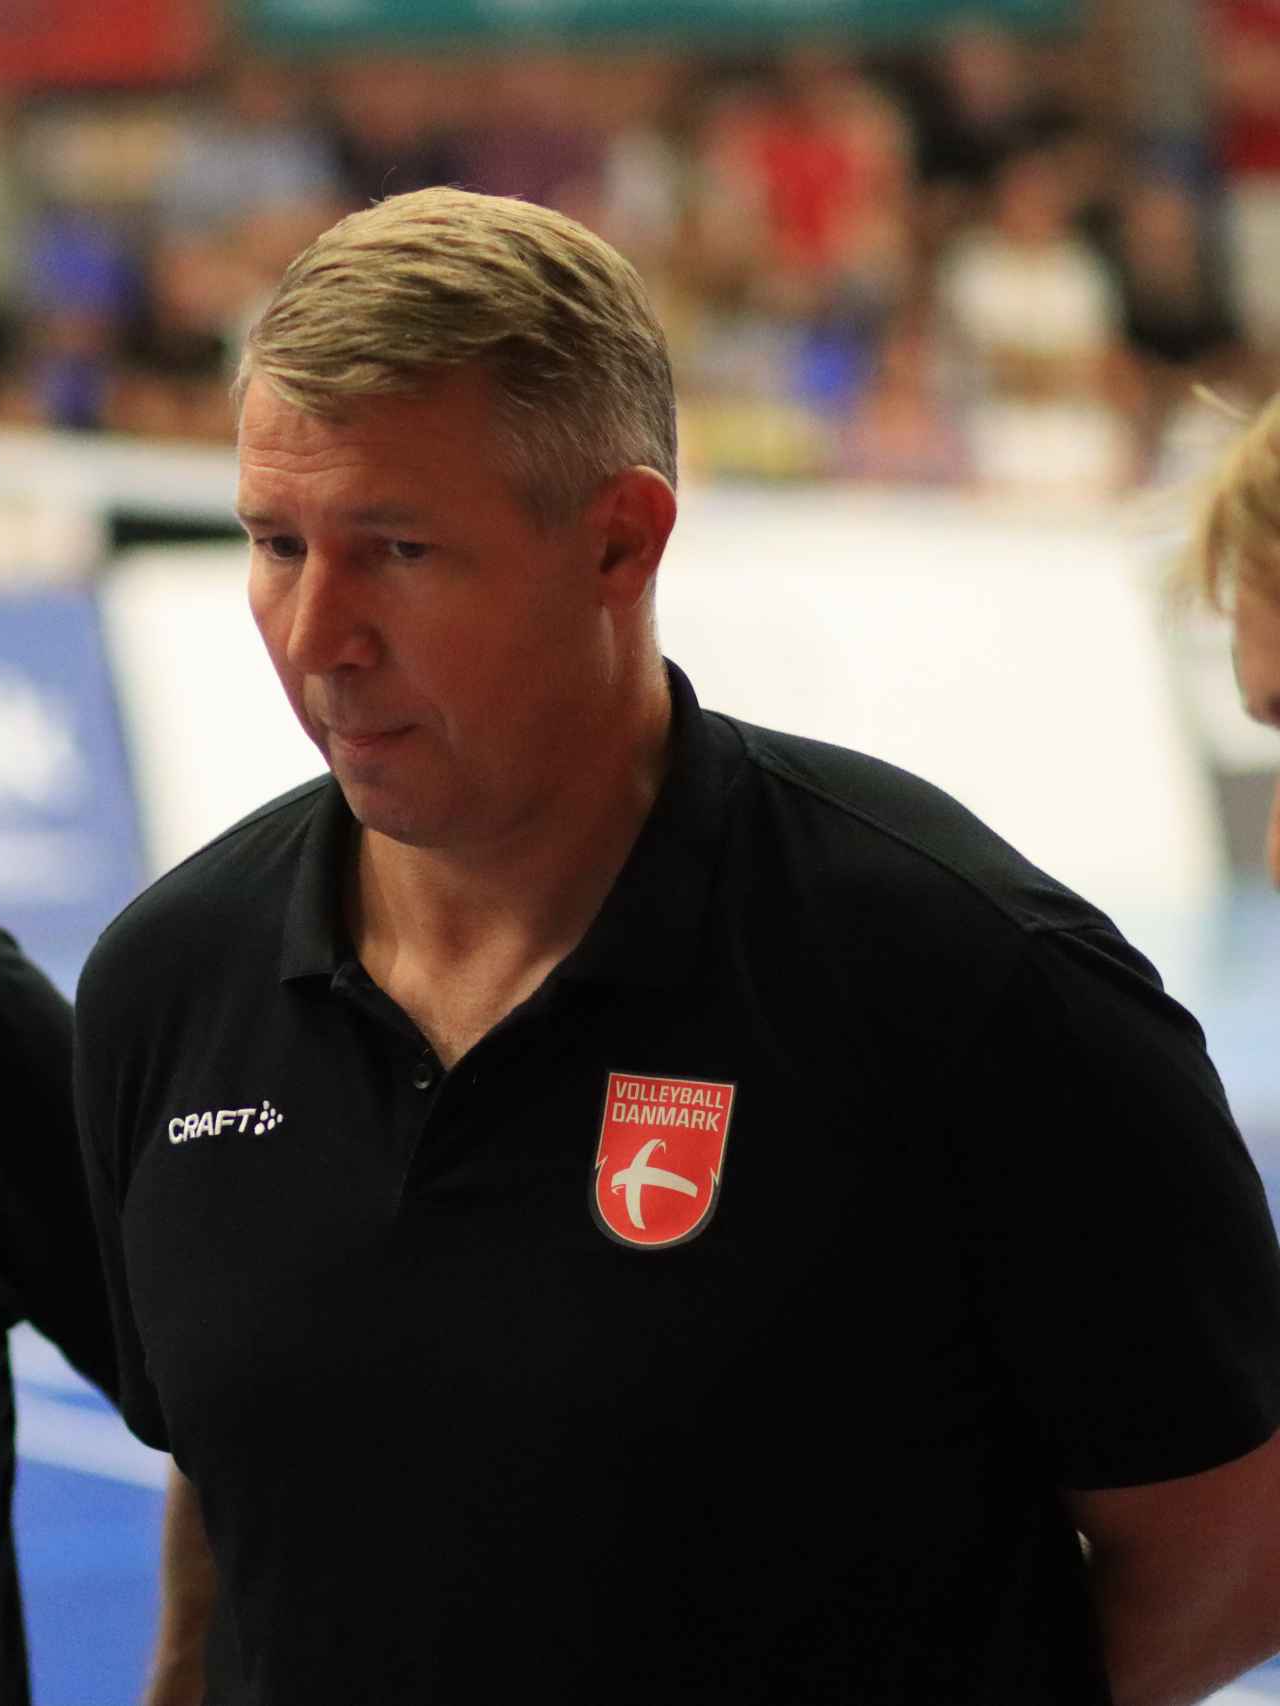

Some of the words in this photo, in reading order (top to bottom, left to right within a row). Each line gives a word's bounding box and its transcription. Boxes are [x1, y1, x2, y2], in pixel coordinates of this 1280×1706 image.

[615, 1080, 724, 1109] VOLLEYBALL
[168, 1108, 257, 1145] CRAFT
[611, 1102, 721, 1132] DANMARK
